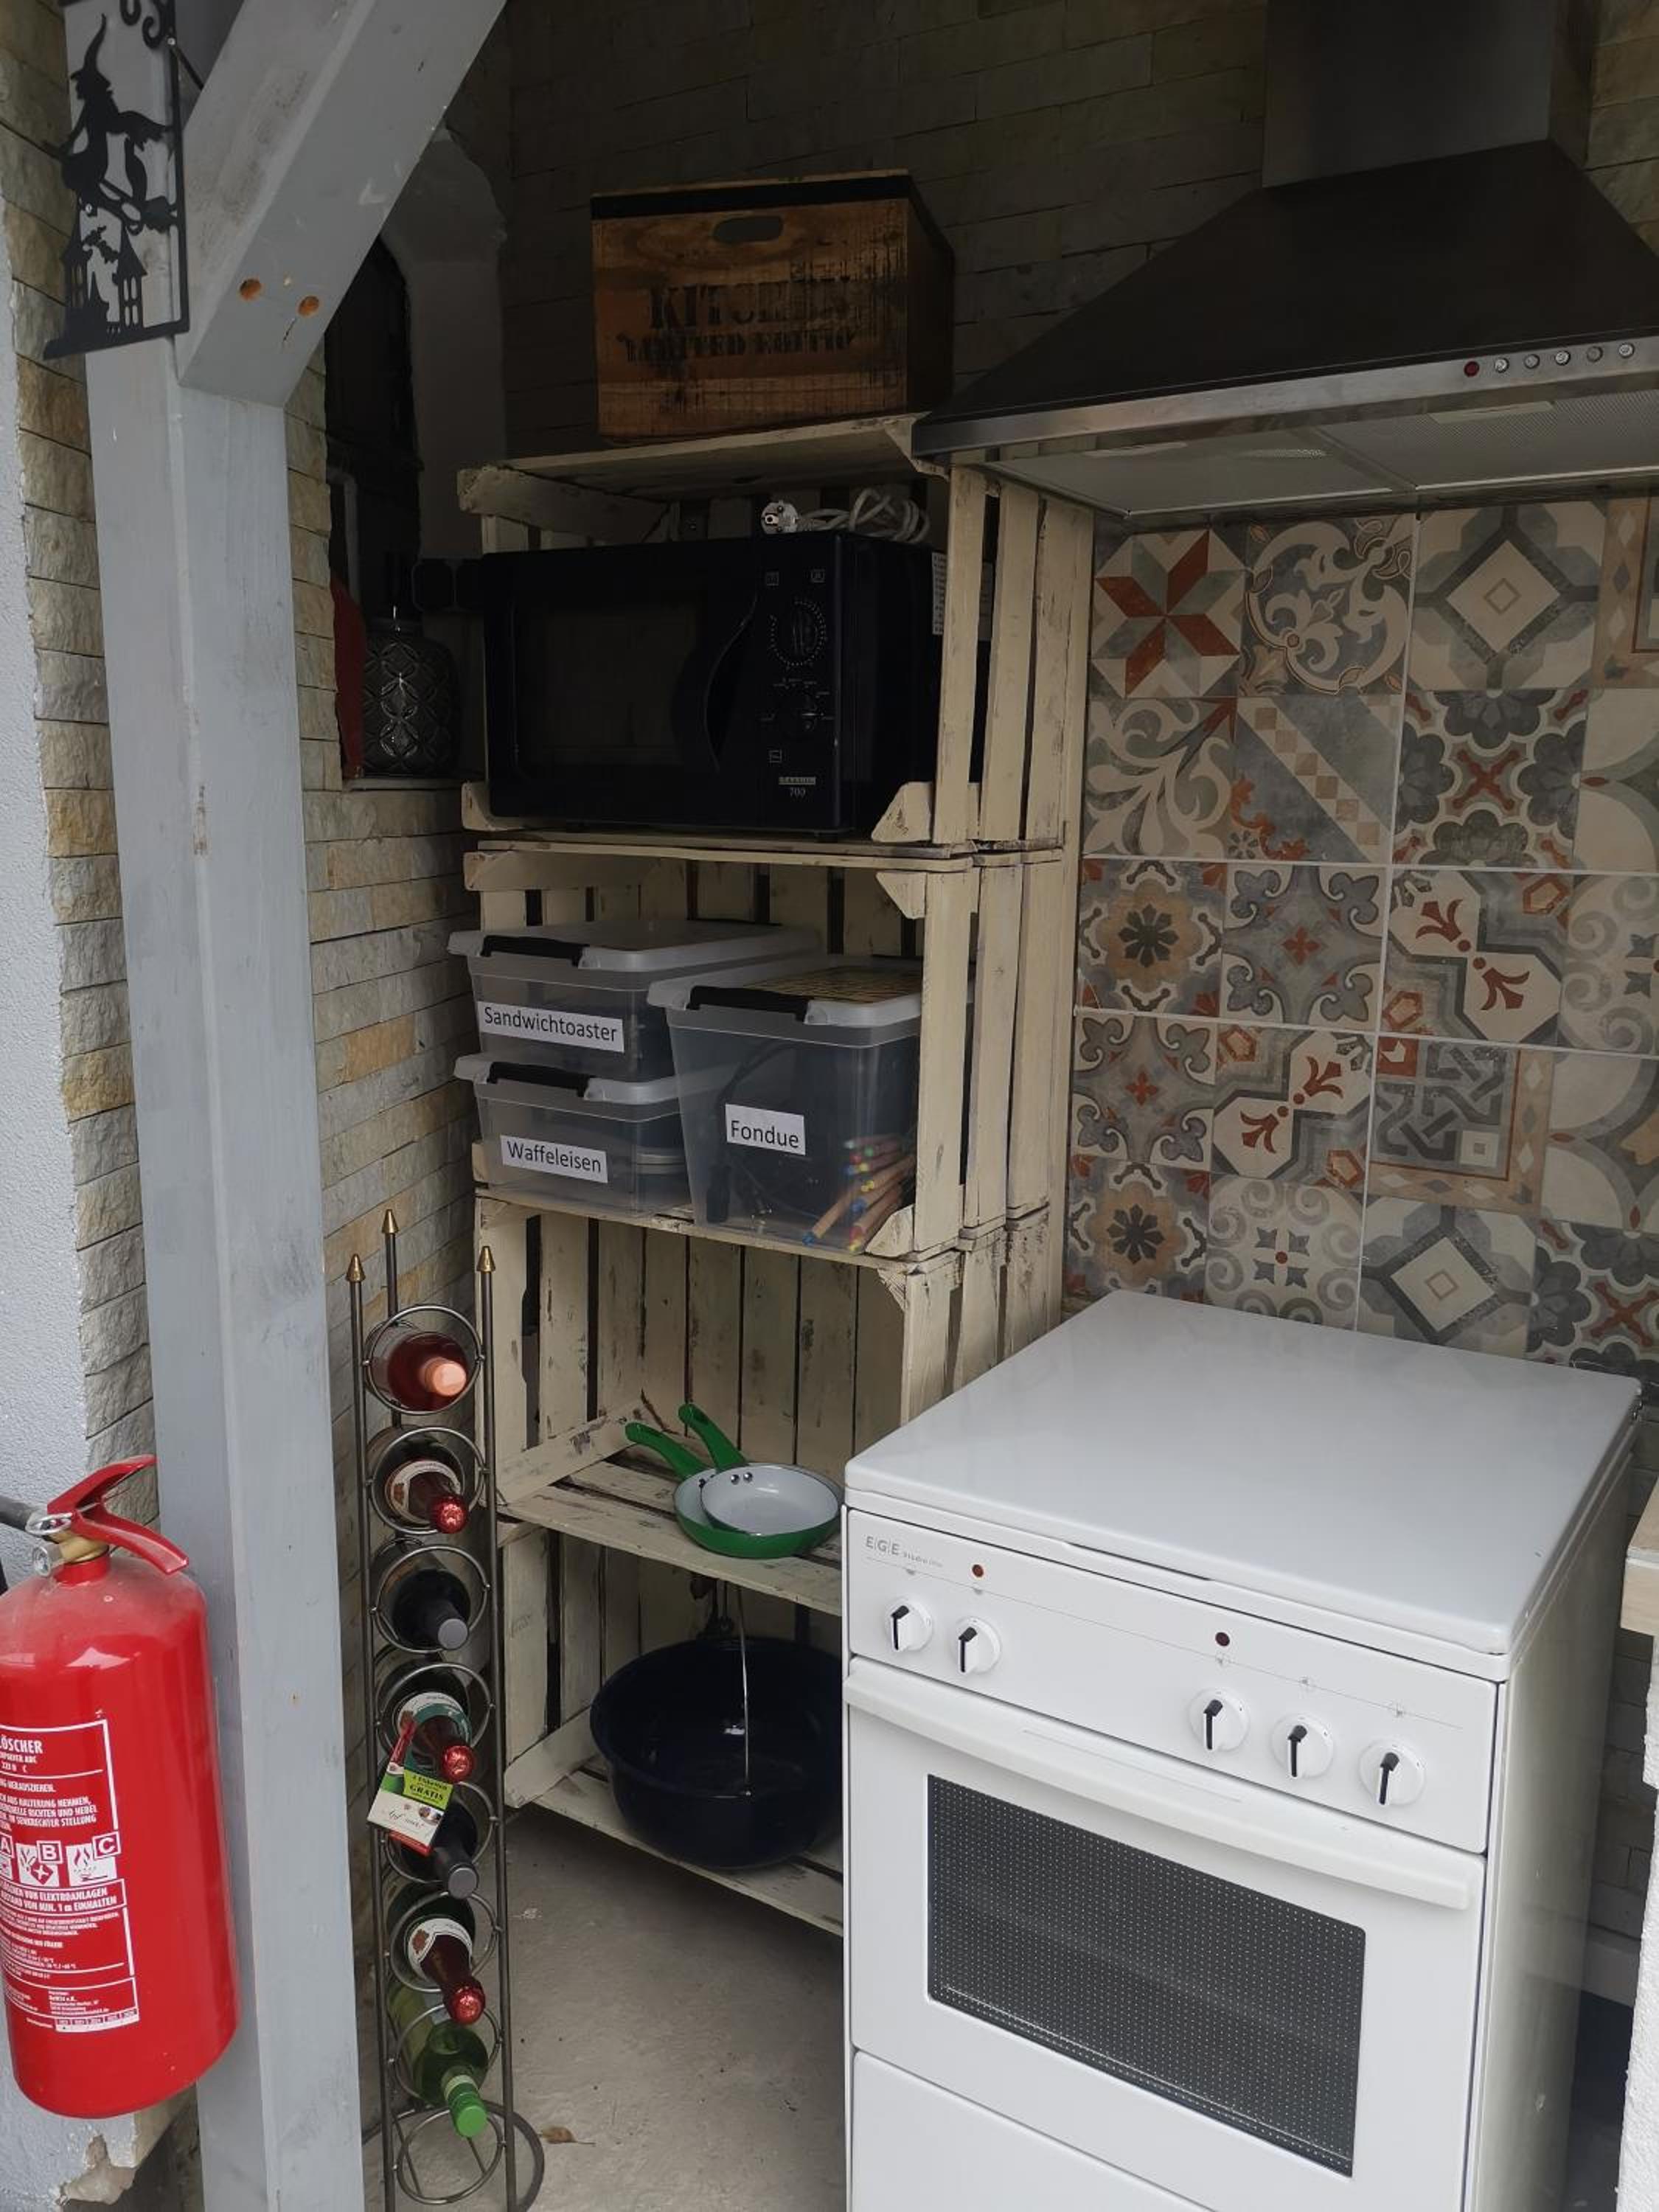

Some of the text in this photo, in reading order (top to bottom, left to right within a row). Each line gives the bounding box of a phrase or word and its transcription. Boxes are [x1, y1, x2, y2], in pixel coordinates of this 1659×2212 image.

[484, 1006, 617, 1043] Sandwichtoaster
[730, 1120, 799, 1148] Fondue
[507, 1141, 601, 1173] Waffeleisen
[0, 1837, 10, 1854] A
[43, 1846, 58, 1860] B
[98, 1837, 116, 1854] C
[58, 1902, 63, 1912] 1
